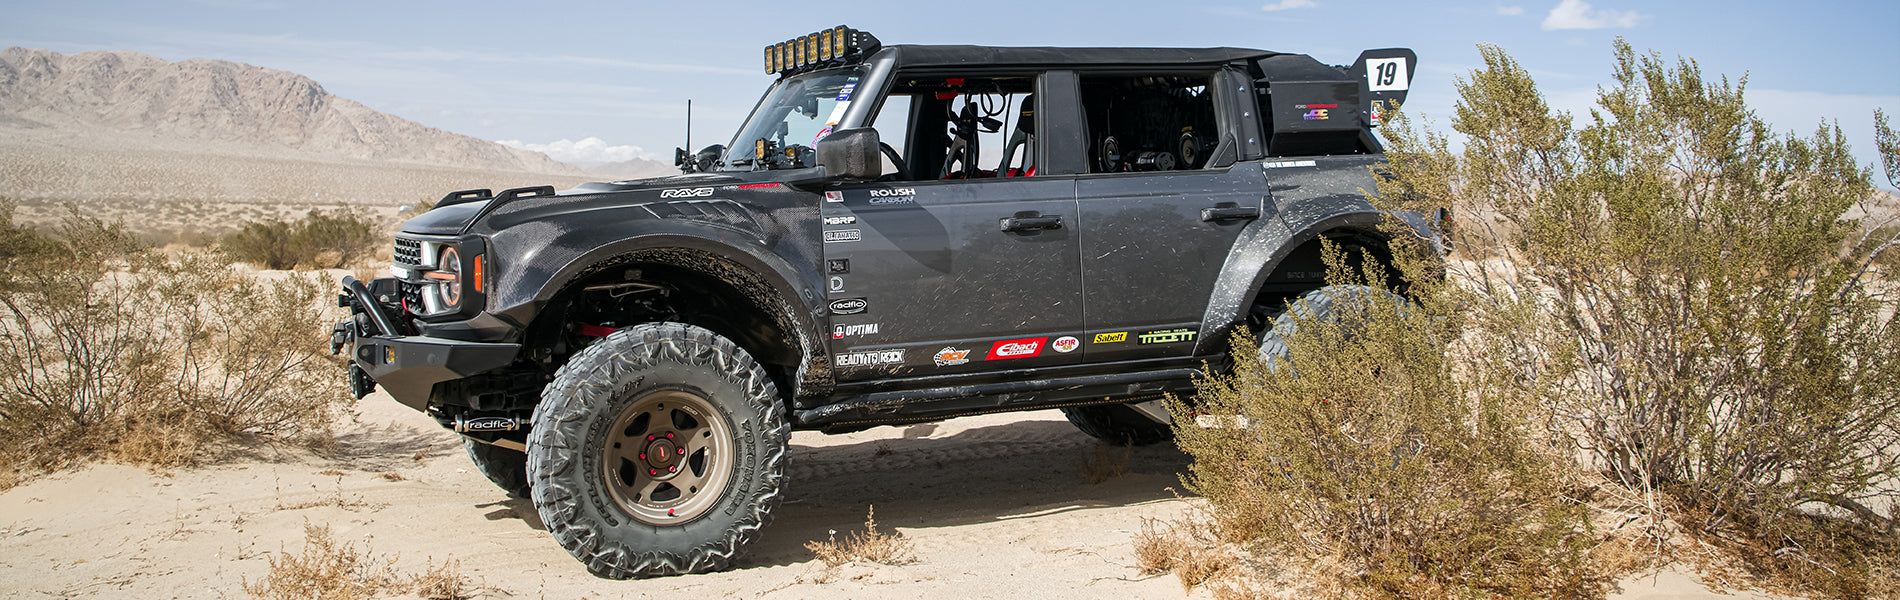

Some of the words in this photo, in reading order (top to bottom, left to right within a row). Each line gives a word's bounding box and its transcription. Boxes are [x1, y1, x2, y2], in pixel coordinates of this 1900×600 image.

[1376, 61, 1397, 86] 19
[660, 187, 714, 198] RAYS
[869, 188, 916, 197] ROUSH
[869, 195, 914, 204] CARBON
[823, 216, 856, 225] MBRP
[833, 301, 864, 309] radflo
[845, 323, 879, 336] OPTIMA
[1055, 339, 1076, 347] ASFIR
[1096, 334, 1124, 343] Sabelt
[996, 341, 1038, 356] Eibach
[836, 353, 865, 367] READY
[940, 351, 967, 361] RCV
[724, 418, 756, 516] YOKOHAMA
